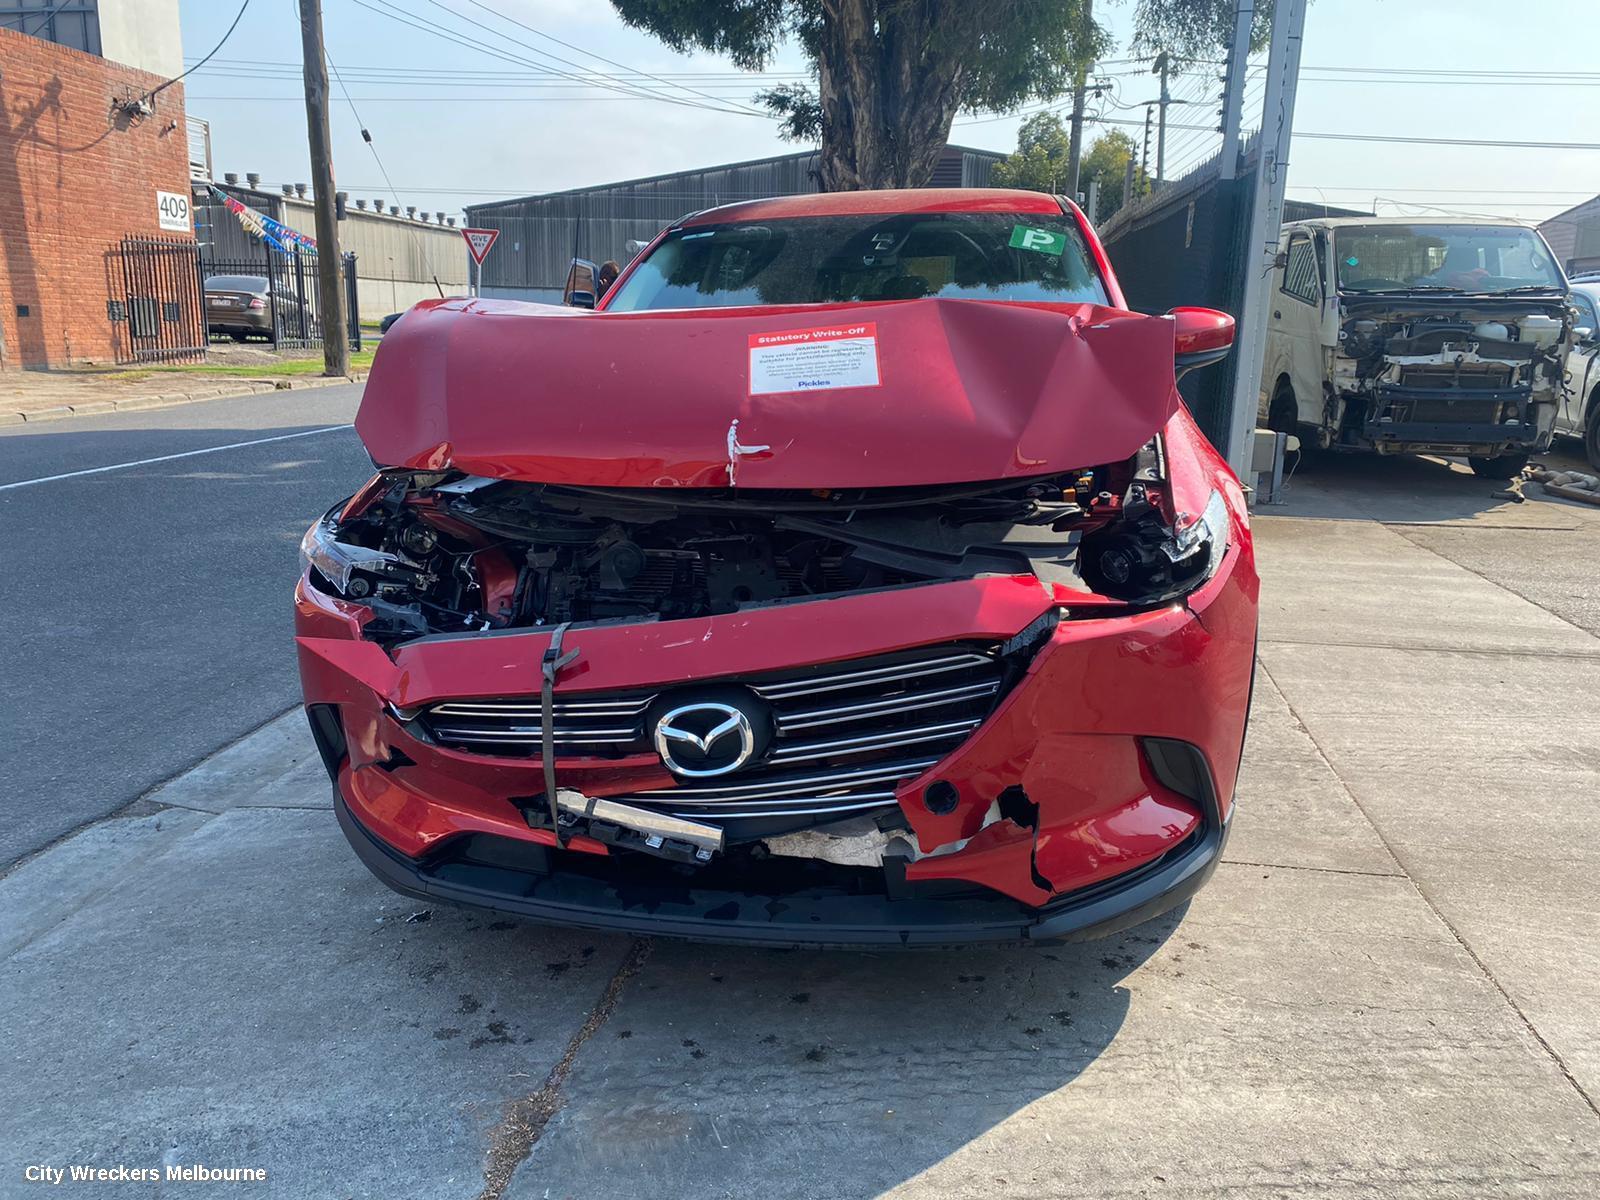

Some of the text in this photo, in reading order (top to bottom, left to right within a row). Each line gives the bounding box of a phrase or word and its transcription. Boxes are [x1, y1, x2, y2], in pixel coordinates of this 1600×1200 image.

[160, 196, 187, 219] 409
[471, 234, 488, 242] GIVE
[1022, 229, 1055, 247] P
[758, 327, 866, 344] Statutory Write-Off
[797, 379, 830, 387] Pickles
